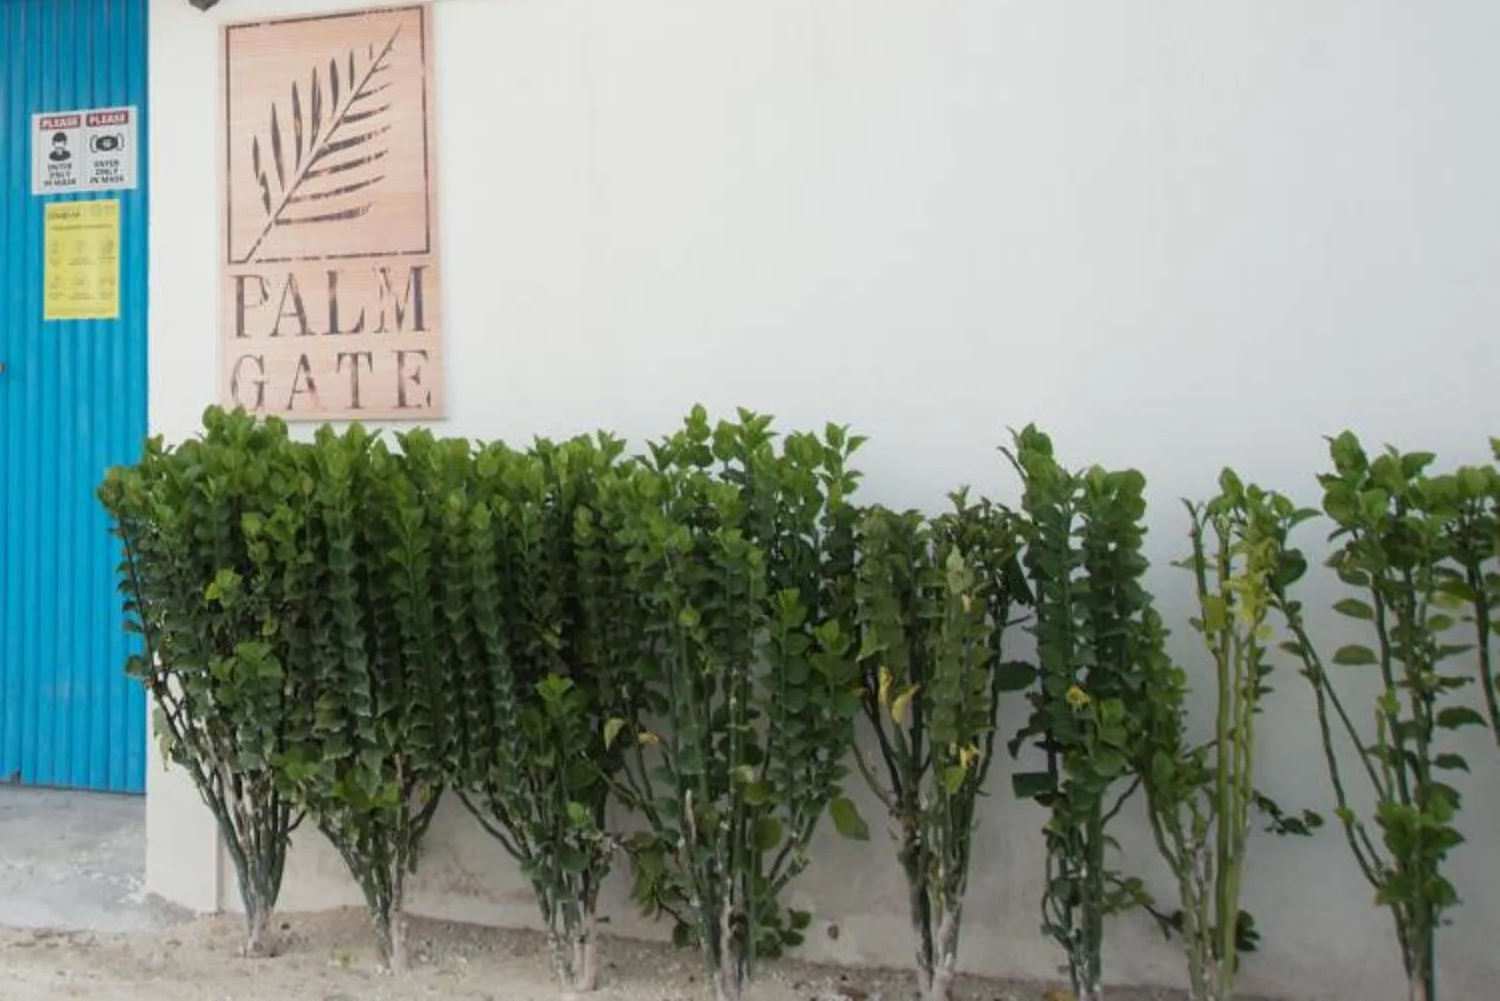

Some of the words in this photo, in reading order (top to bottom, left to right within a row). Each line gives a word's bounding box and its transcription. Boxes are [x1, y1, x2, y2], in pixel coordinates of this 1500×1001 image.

[88, 112, 126, 125] PLEASE
[230, 265, 430, 338] PALM
[231, 349, 431, 411] GATE
